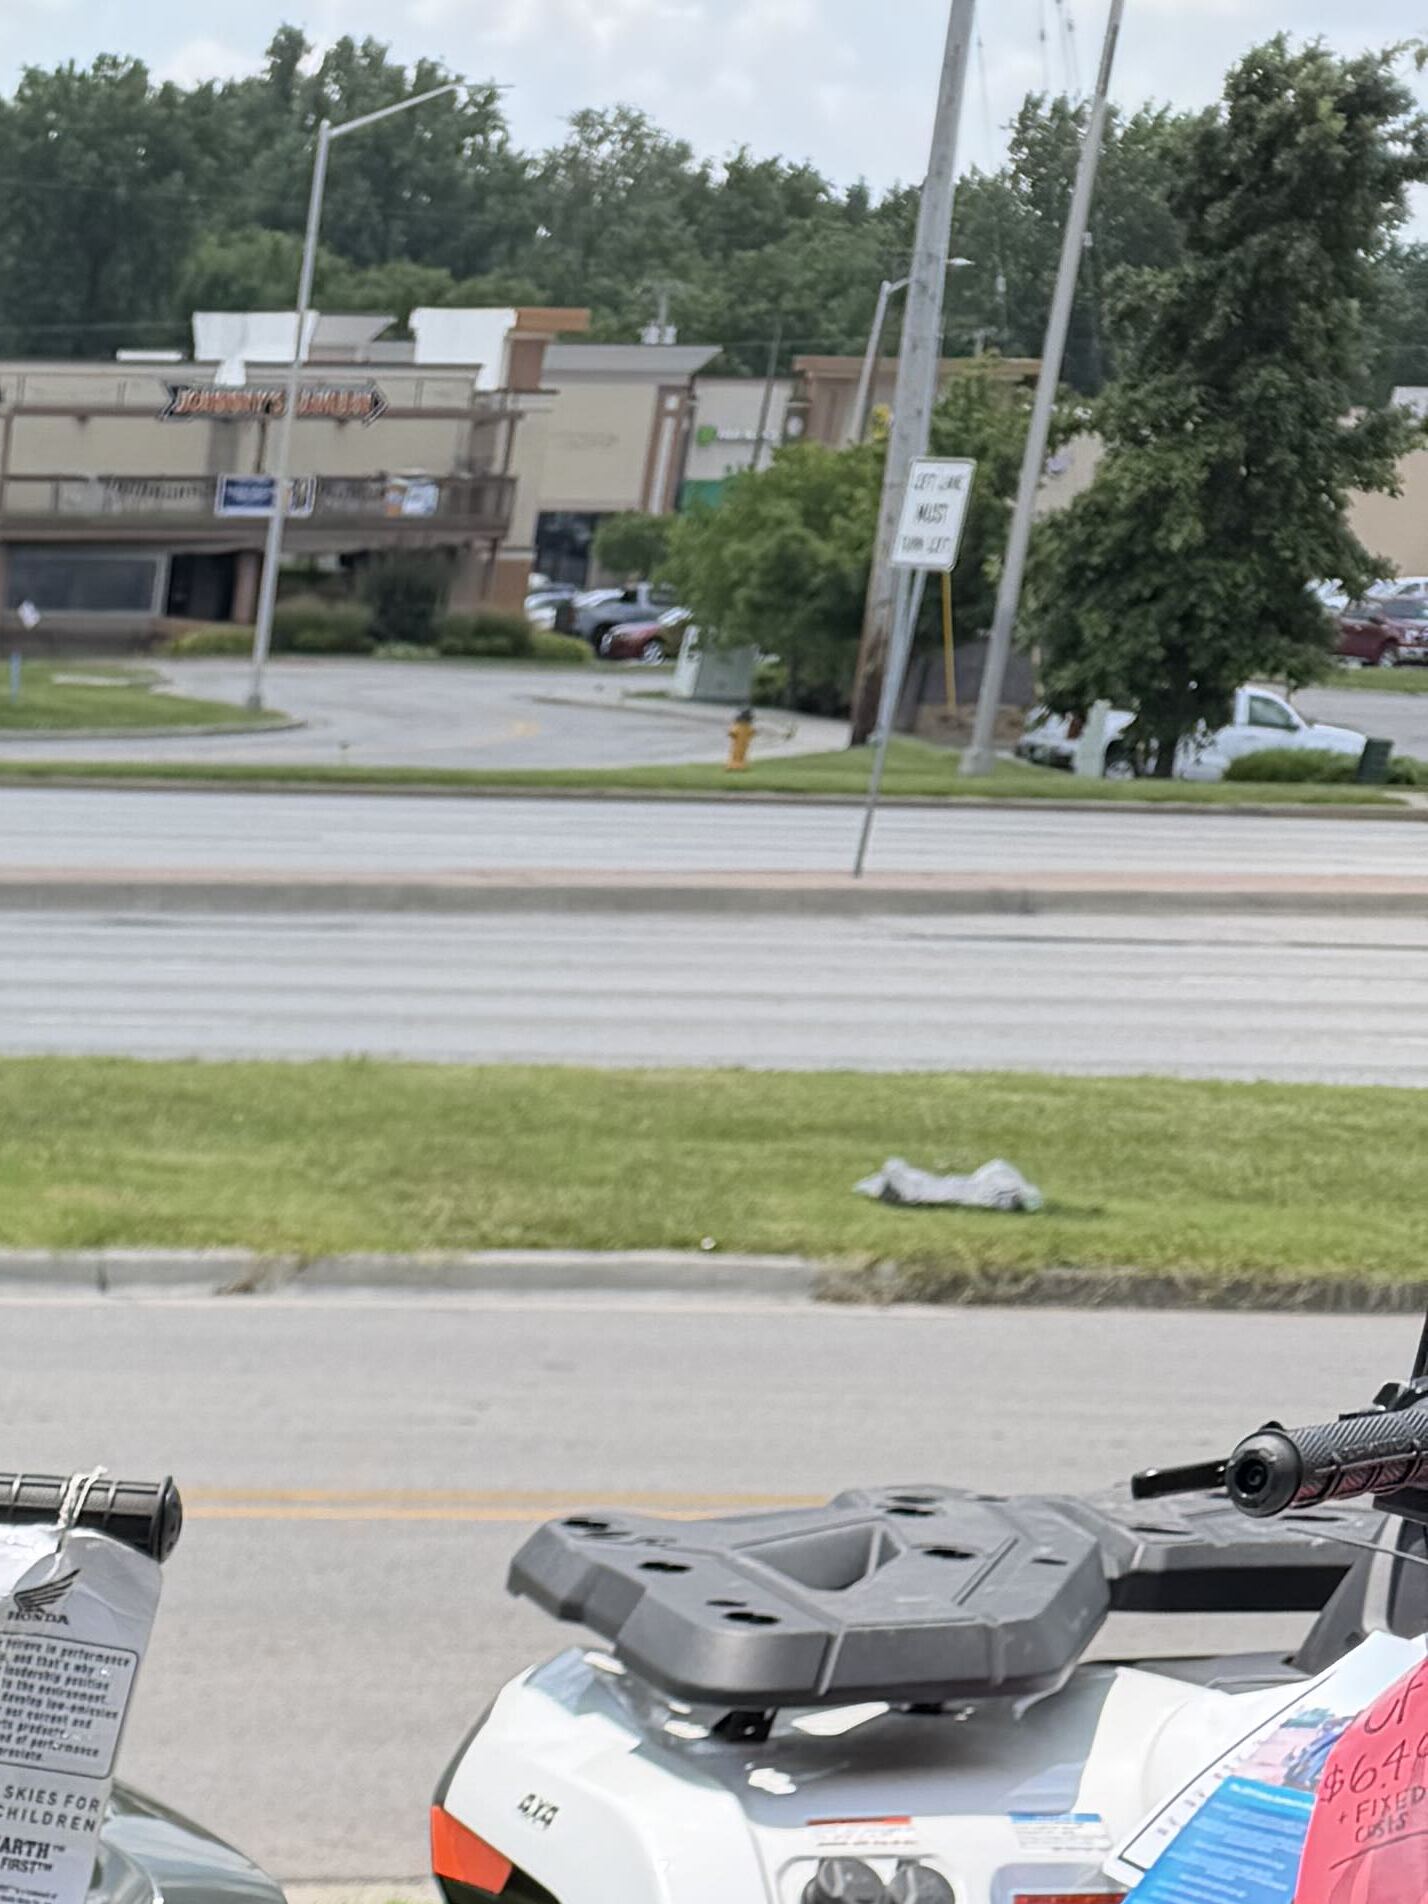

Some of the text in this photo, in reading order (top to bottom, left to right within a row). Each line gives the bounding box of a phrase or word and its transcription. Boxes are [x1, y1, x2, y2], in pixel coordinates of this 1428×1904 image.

[8, 1611, 70, 1625] HONDA
[4, 1785, 57, 1806] SKIES
[62, 1795, 100, 1813] FOR
[1356, 1785, 1426, 1823] FIXED
